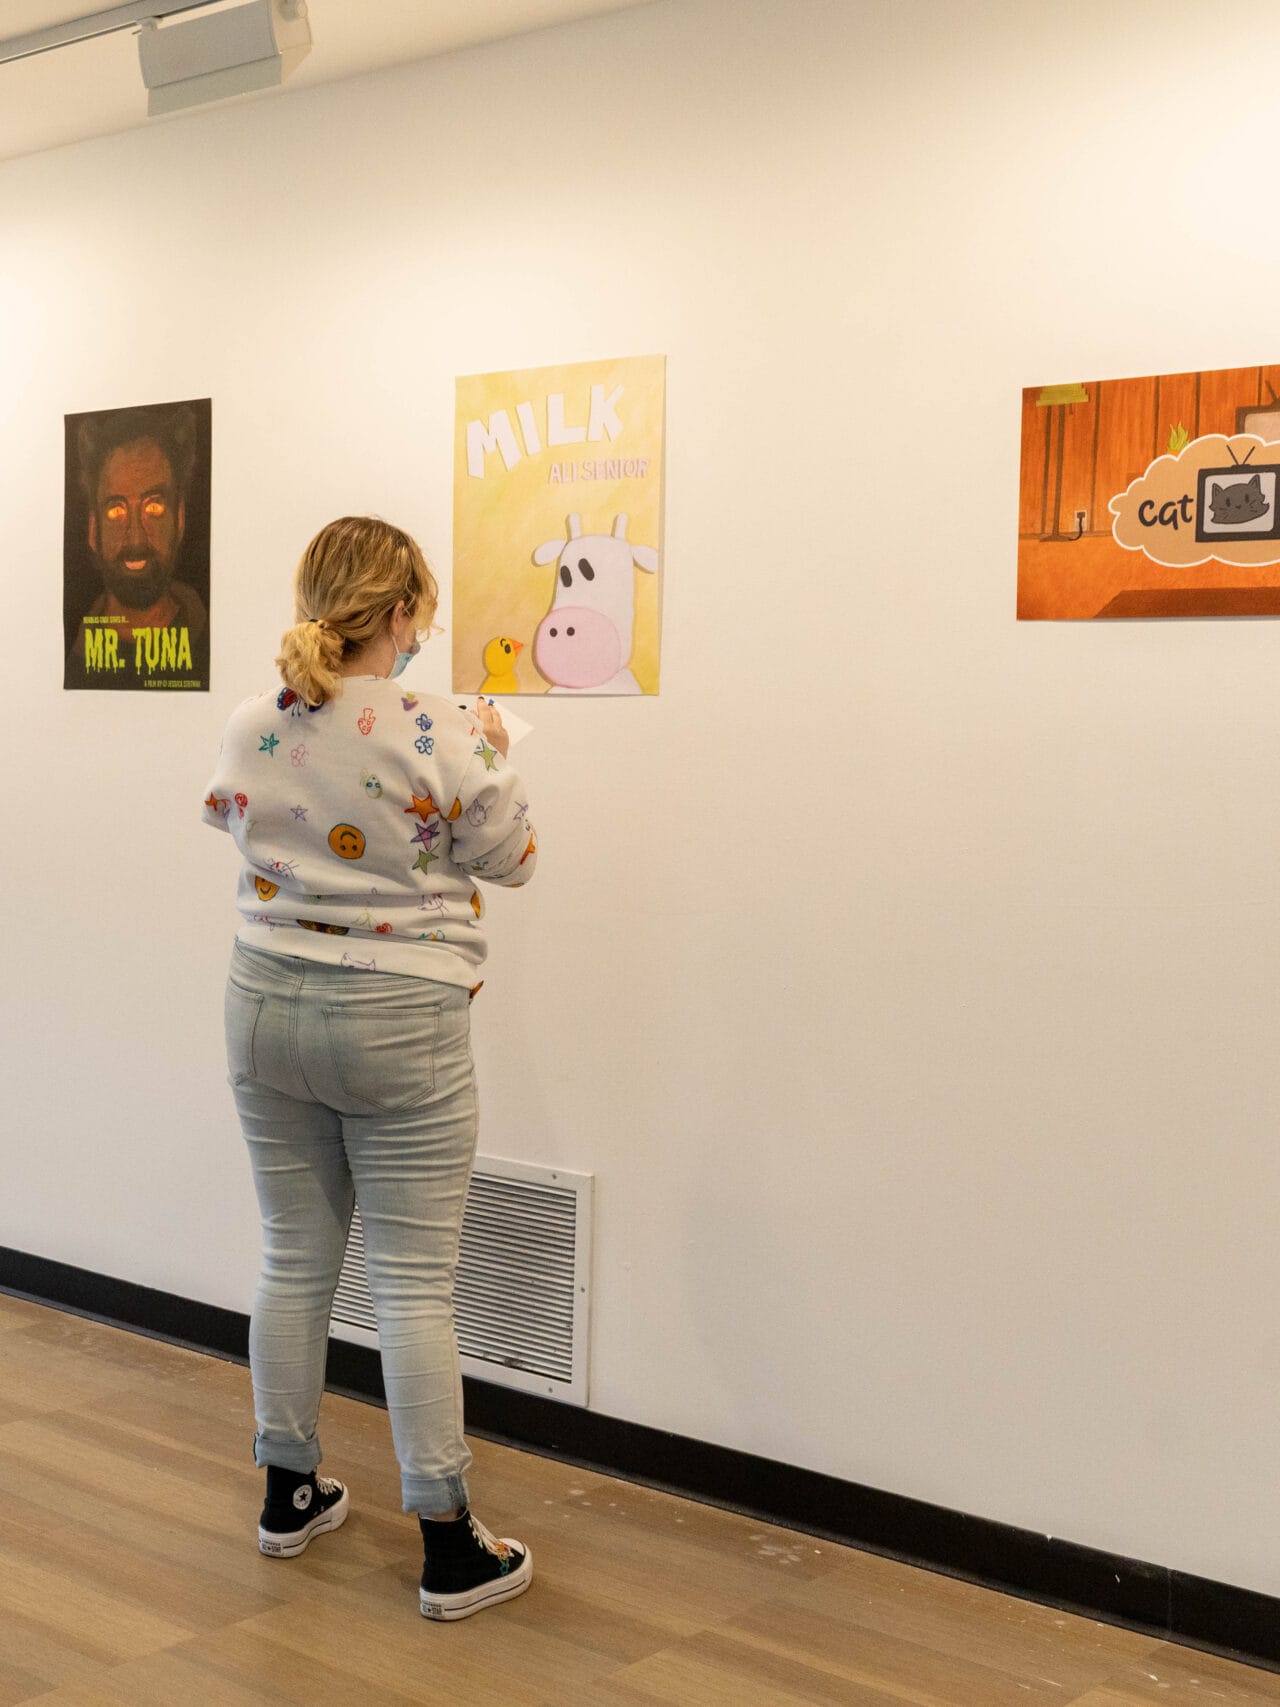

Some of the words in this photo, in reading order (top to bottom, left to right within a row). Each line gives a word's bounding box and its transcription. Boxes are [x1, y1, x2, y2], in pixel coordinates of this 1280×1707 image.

[467, 384, 625, 479] MILK
[549, 461, 578, 484] ALI
[582, 457, 650, 481] SENIOR
[1138, 494, 1194, 531] cat
[85, 627, 126, 674] MR.
[132, 626, 192, 676] TUNA
